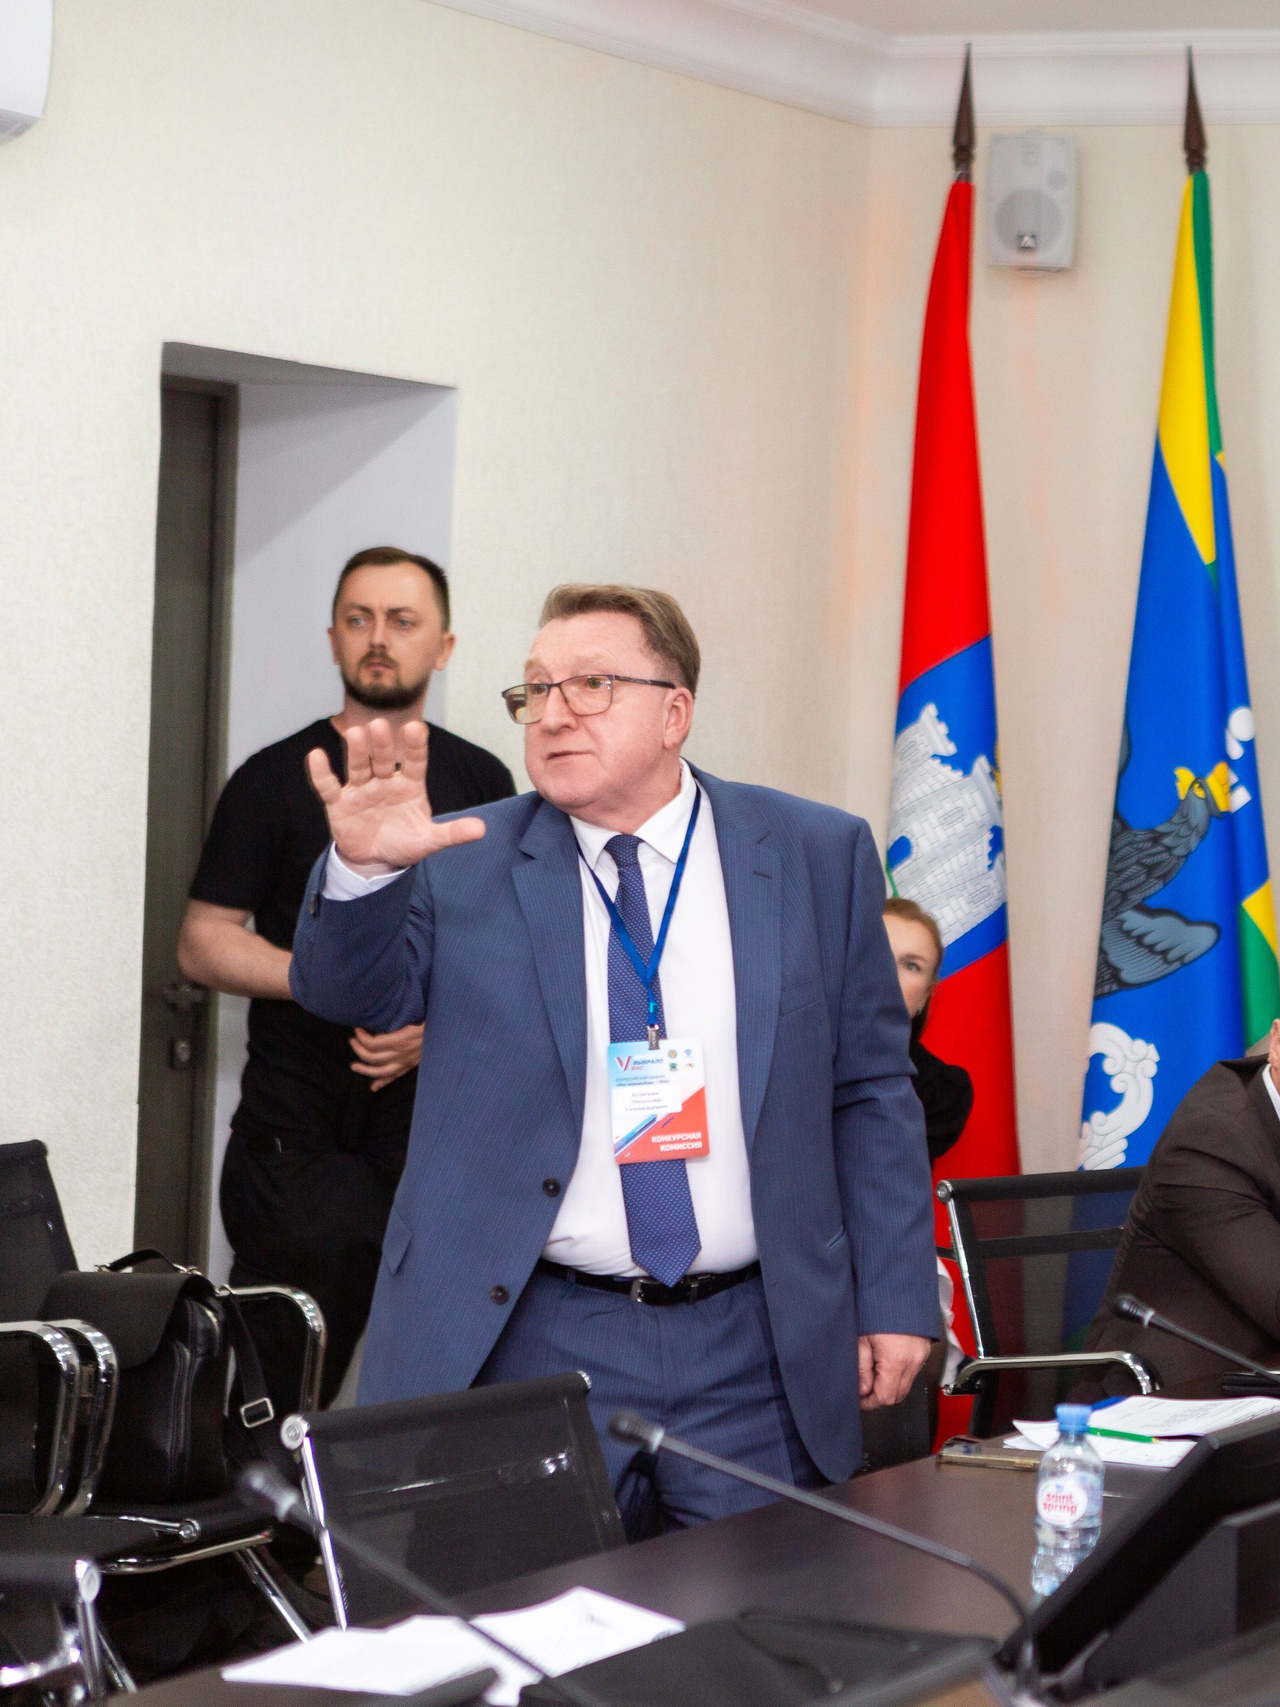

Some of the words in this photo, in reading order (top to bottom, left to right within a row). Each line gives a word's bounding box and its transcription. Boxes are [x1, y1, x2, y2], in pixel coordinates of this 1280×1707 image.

[651, 1132, 702, 1144] КОНКУРСНАЯ
[660, 1141, 703, 1152] КОМИССИЯ
[1046, 1493, 1073, 1503] saint
[1043, 1503, 1077, 1515] spring
